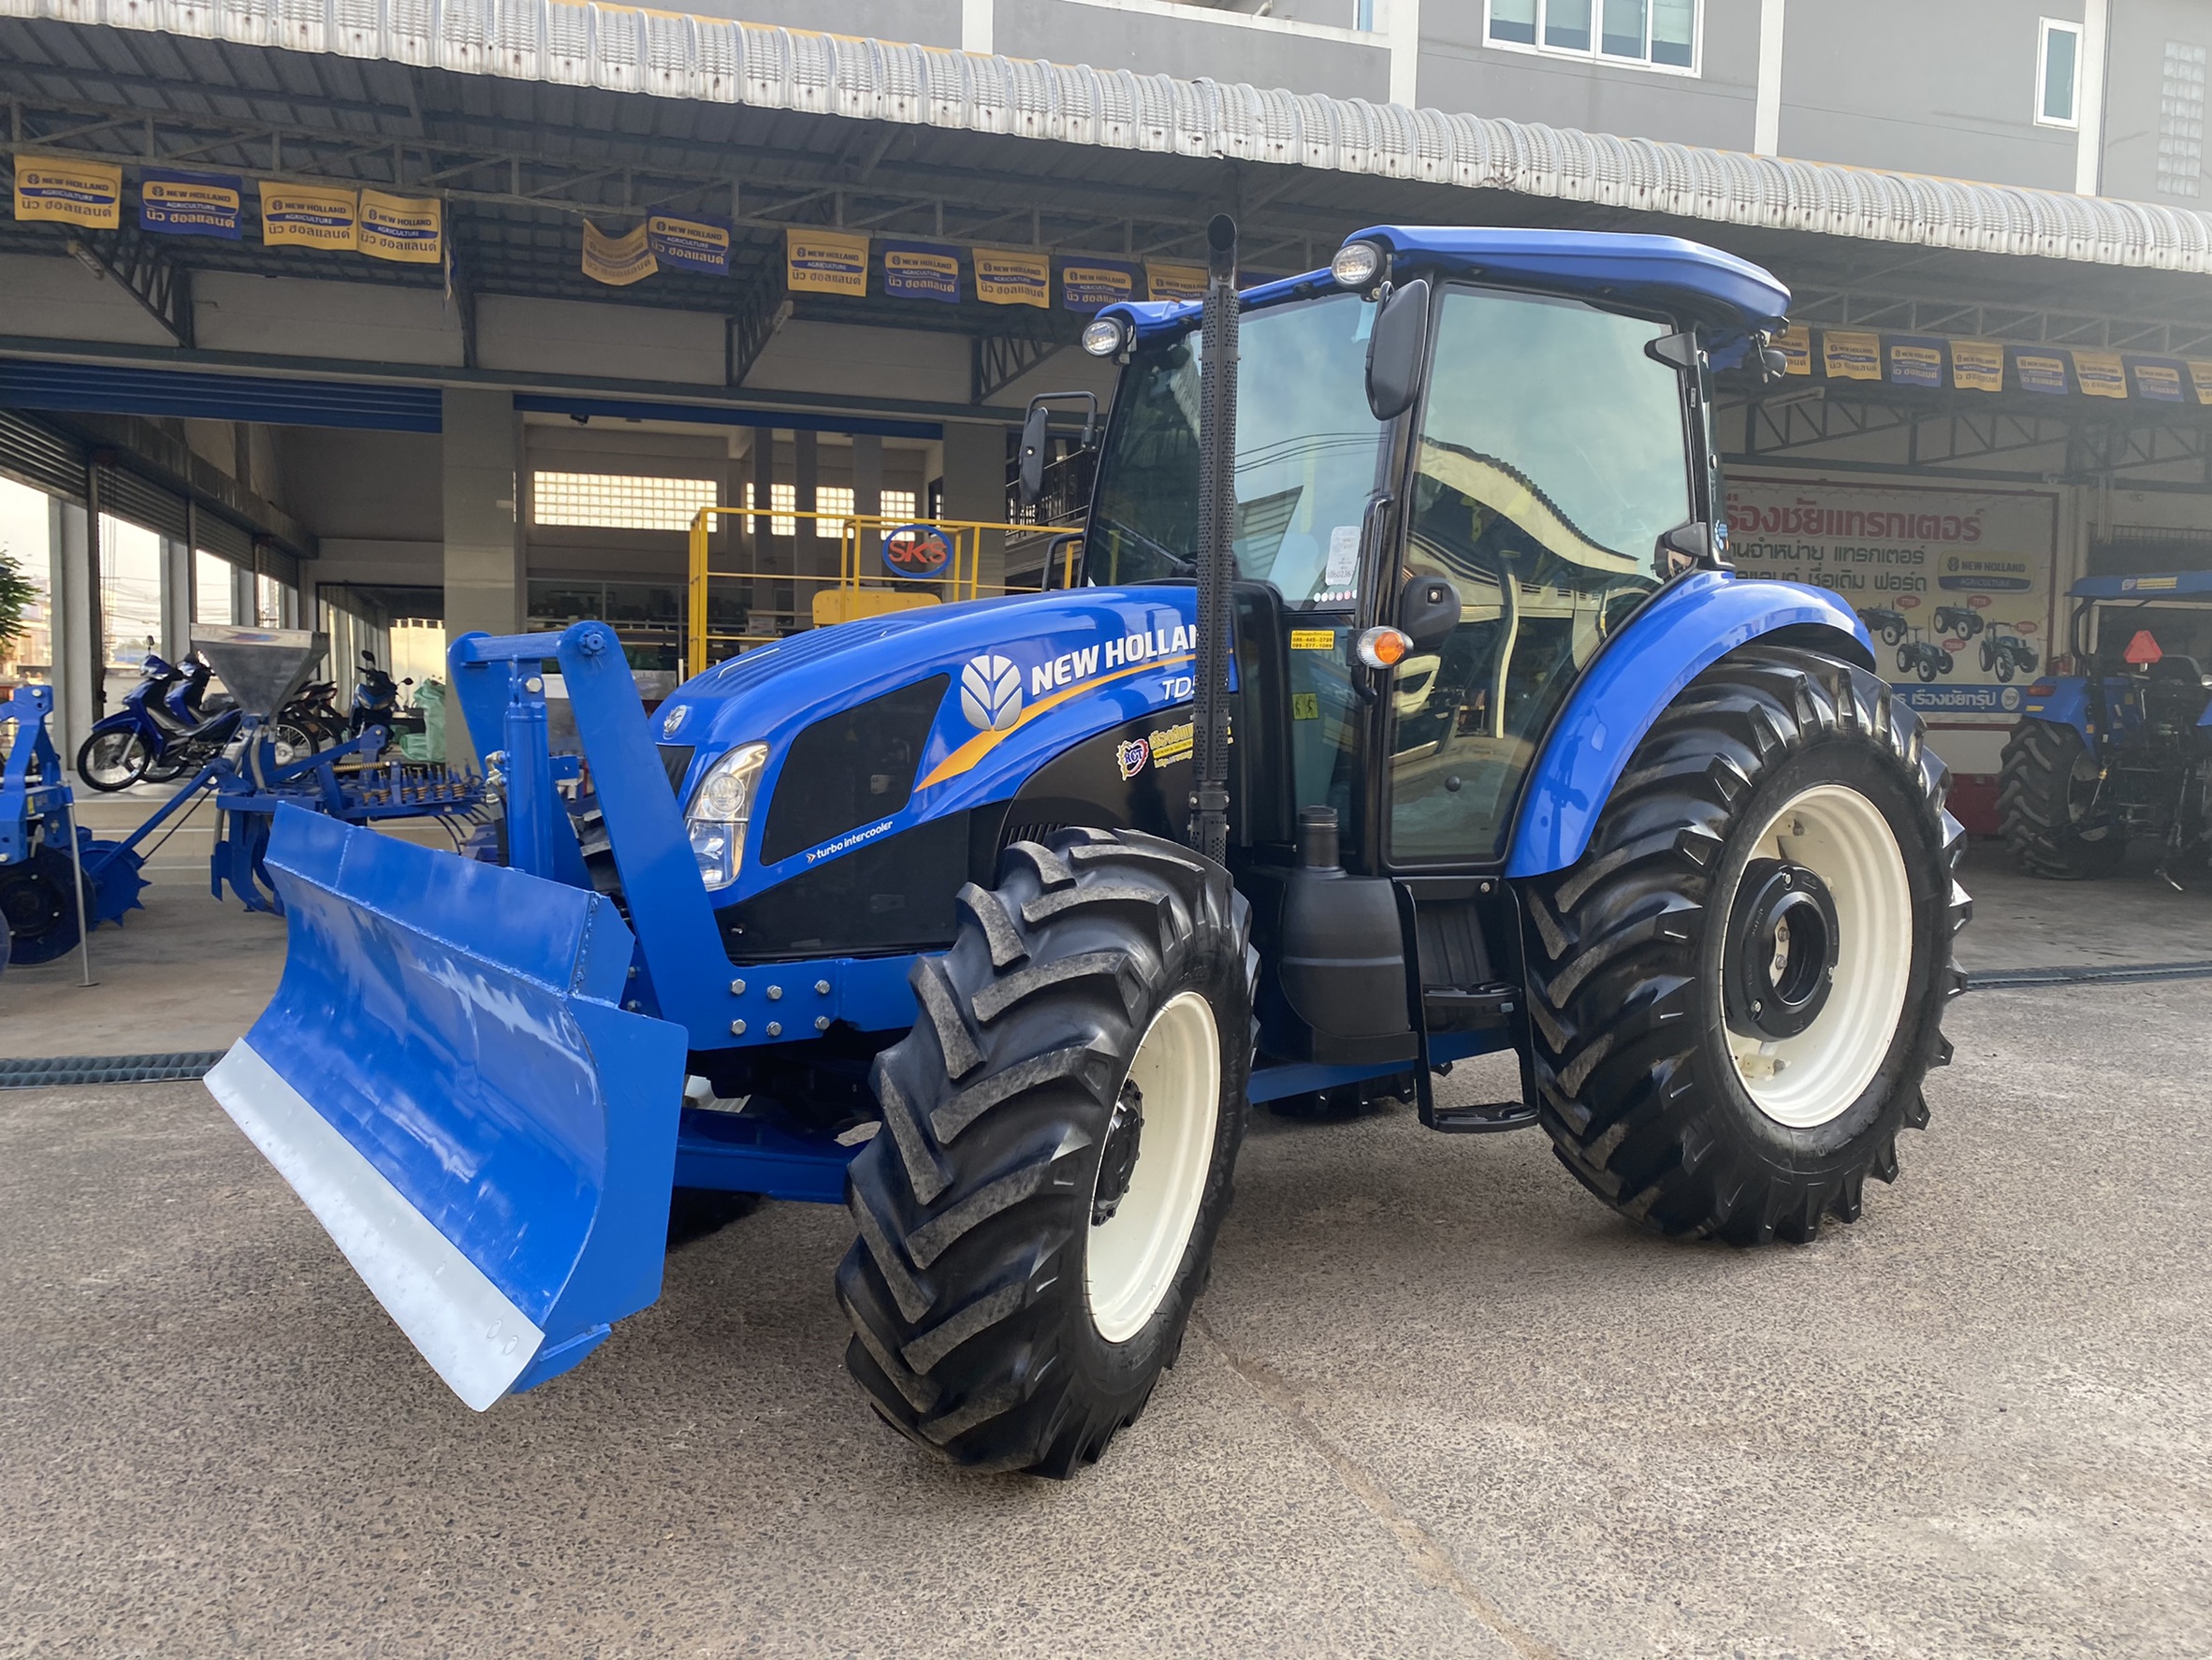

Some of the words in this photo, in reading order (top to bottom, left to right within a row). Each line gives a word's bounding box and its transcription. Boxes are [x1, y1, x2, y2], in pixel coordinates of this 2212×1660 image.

[42, 177, 64, 186] NEW
[65, 180, 109, 192] HOLLAND
[41, 189, 94, 202] AGRICULTURE
[167, 189, 188, 198] NEW
[189, 192, 231, 203] HOLLAND
[22, 197, 40, 210] นิว
[45, 199, 112, 218] ฮอลแลนด์
[167, 201, 216, 211] AGRICULTURE
[284, 202, 306, 211] NEW
[306, 203, 346, 214] HOLLAND
[146, 208, 166, 221] นิว
[169, 212, 236, 228] ฮอลแลนด์
[284, 213, 333, 225] AGRICULTURE
[379, 214, 396, 224] NEW
[397, 218, 431, 226] HOLLAND
[269, 223, 284, 235] นิว
[289, 226, 351, 240] ฮอลแลนด์
[377, 226, 420, 237] AGRICULTURE
[667, 225, 687, 234] NEW
[688, 228, 723, 241] HOLLAND
[360, 231, 376, 244] นิว
[380, 238, 437, 253] ฮอลแลนด์
[666, 235, 709, 249] AGRICULTURE
[668, 247, 725, 266] ฮอลแลนด์
[808, 250, 826, 258] NEW
[826, 253, 860, 262] HOLLAND
[807, 261, 847, 270] AGRICULTURE
[902, 257, 920, 267] NEW
[920, 259, 953, 270] HOLLAND
[993, 265, 1011, 273] NEW
[1011, 266, 1041, 276] HOLLAND
[793, 269, 807, 281] นิว
[810, 271, 862, 286] ฮอลแลนด์
[901, 269, 940, 278] AGRICULTURE
[994, 274, 1031, 284] AGRICULTURE
[1096, 275, 1127, 284] HOLLAND
[888, 275, 904, 288] นิว
[906, 278, 955, 293] ฮอลแลนด์
[981, 282, 994, 293] นิว
[996, 284, 1044, 299] ฮอลแลนด์
[1079, 284, 1115, 293] AGRICULTURE
[1067, 291, 1079, 302] นิว
[888, 539, 948, 564] SKS
[1834, 545, 1926, 565] แทรกเตอร์
[1961, 561, 1982, 572] NEW
[1984, 561, 2026, 573] HOLLAND
[1874, 571, 1927, 591] ฟอร์ด
[1960, 577, 2011, 588] AGRICULTURE
[1031, 645, 1099, 696] NEW
[1124, 748, 1144, 764] RCT
[816, 841, 843, 858] turbo
[844, 821, 894, 848] intercooler
